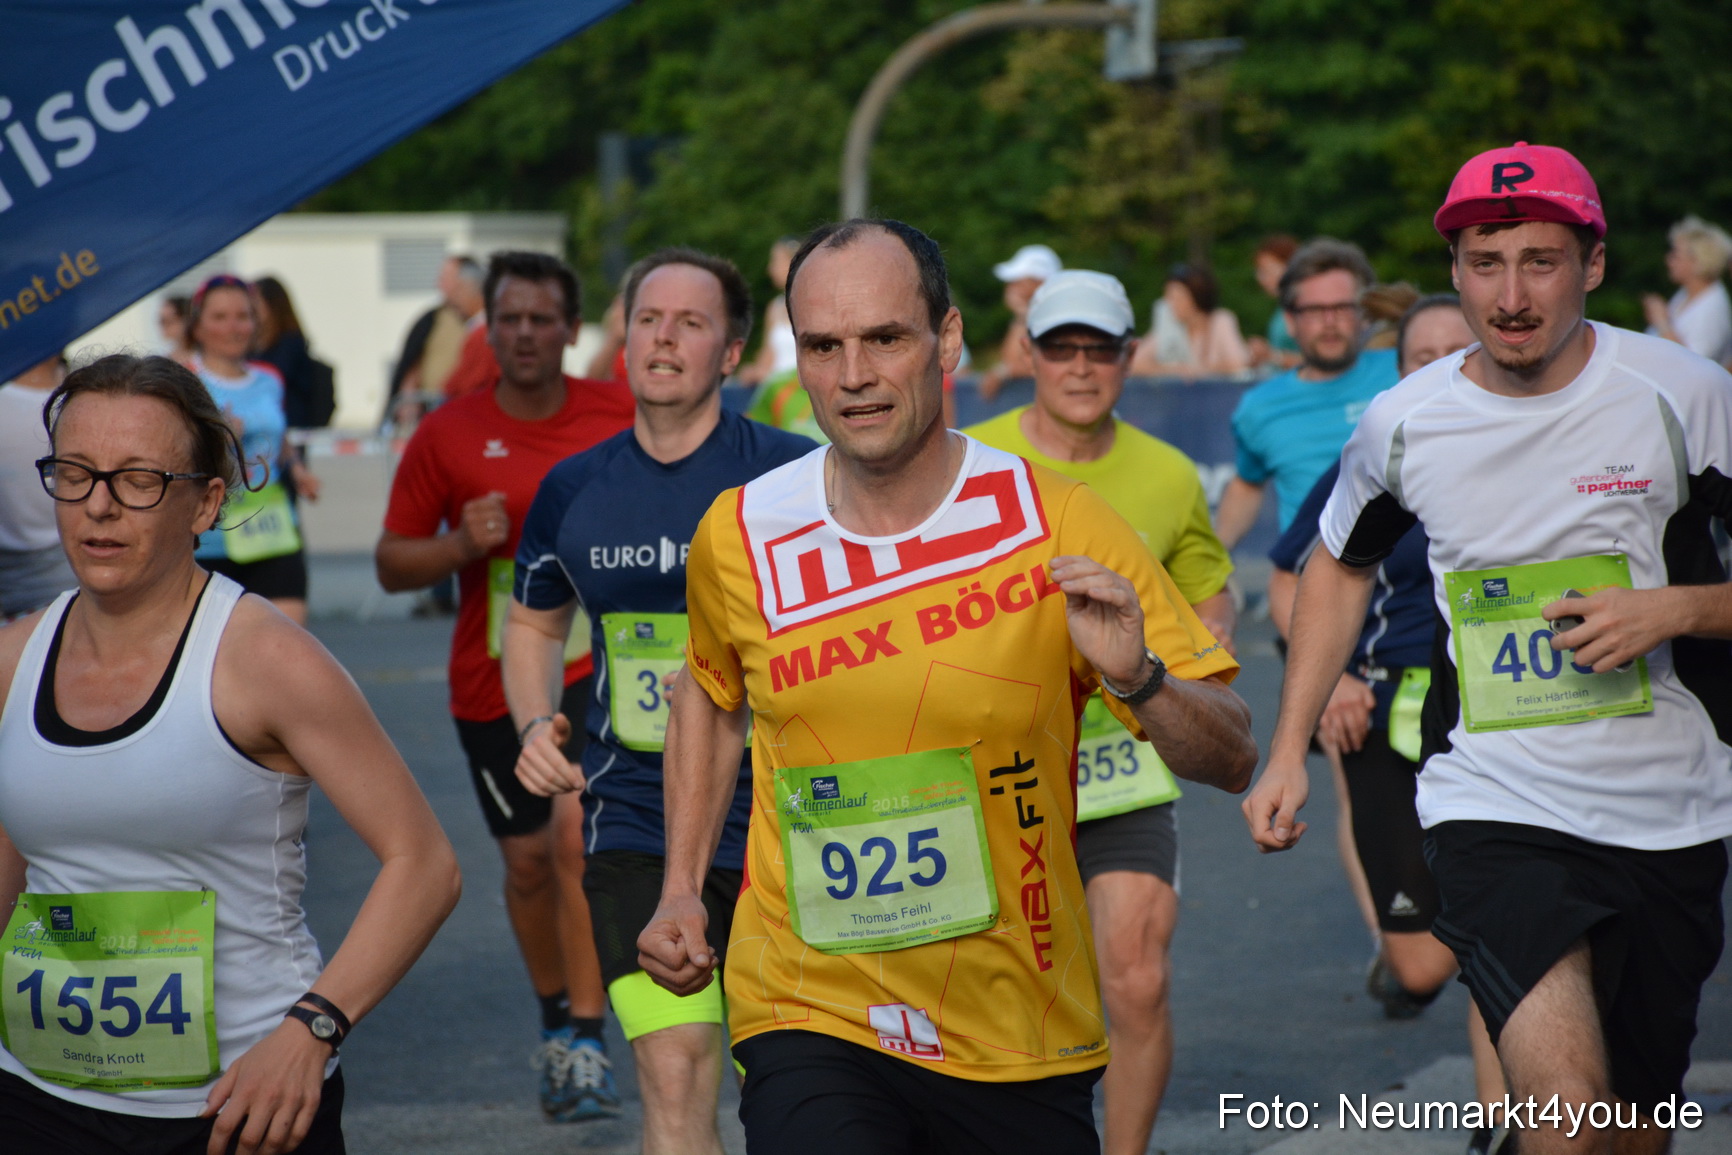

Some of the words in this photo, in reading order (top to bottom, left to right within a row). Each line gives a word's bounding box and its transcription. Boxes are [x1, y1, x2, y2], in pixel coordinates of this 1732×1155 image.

[272, 0, 411, 92] Druck
[1491, 161, 1535, 194] R
[1570, 473, 1625, 486] guttenberger
[1605, 465, 1635, 475] TEAM
[1587, 479, 1653, 495] partner
[1604, 487, 1649, 498] LICHTWERBUNG
[590, 545, 655, 570] EURO
[1475, 591, 1535, 609] firmenlauf
[769, 619, 902, 694] MAX
[916, 563, 1061, 646] BÖGL
[1516, 695, 1543, 706] Felix
[1545, 689, 1589, 703] Härtlein
[803, 792, 868, 812] firmenlauf
[872, 795, 911, 813] 2016
[821, 827, 947, 900] 925
[851, 910, 898, 926] Thomas
[900, 902, 932, 919] Feihl
[837, 931, 850, 939] Max
[851, 929, 865, 939] Bögl
[866, 926, 900, 937] Bauservice
[900, 920, 921, 931] GmbH
[941, 914, 952, 922] KG
[17, 969, 192, 1038] 1554
[62, 1048, 104, 1065] Sandra
[107, 1053, 146, 1065] Knott
